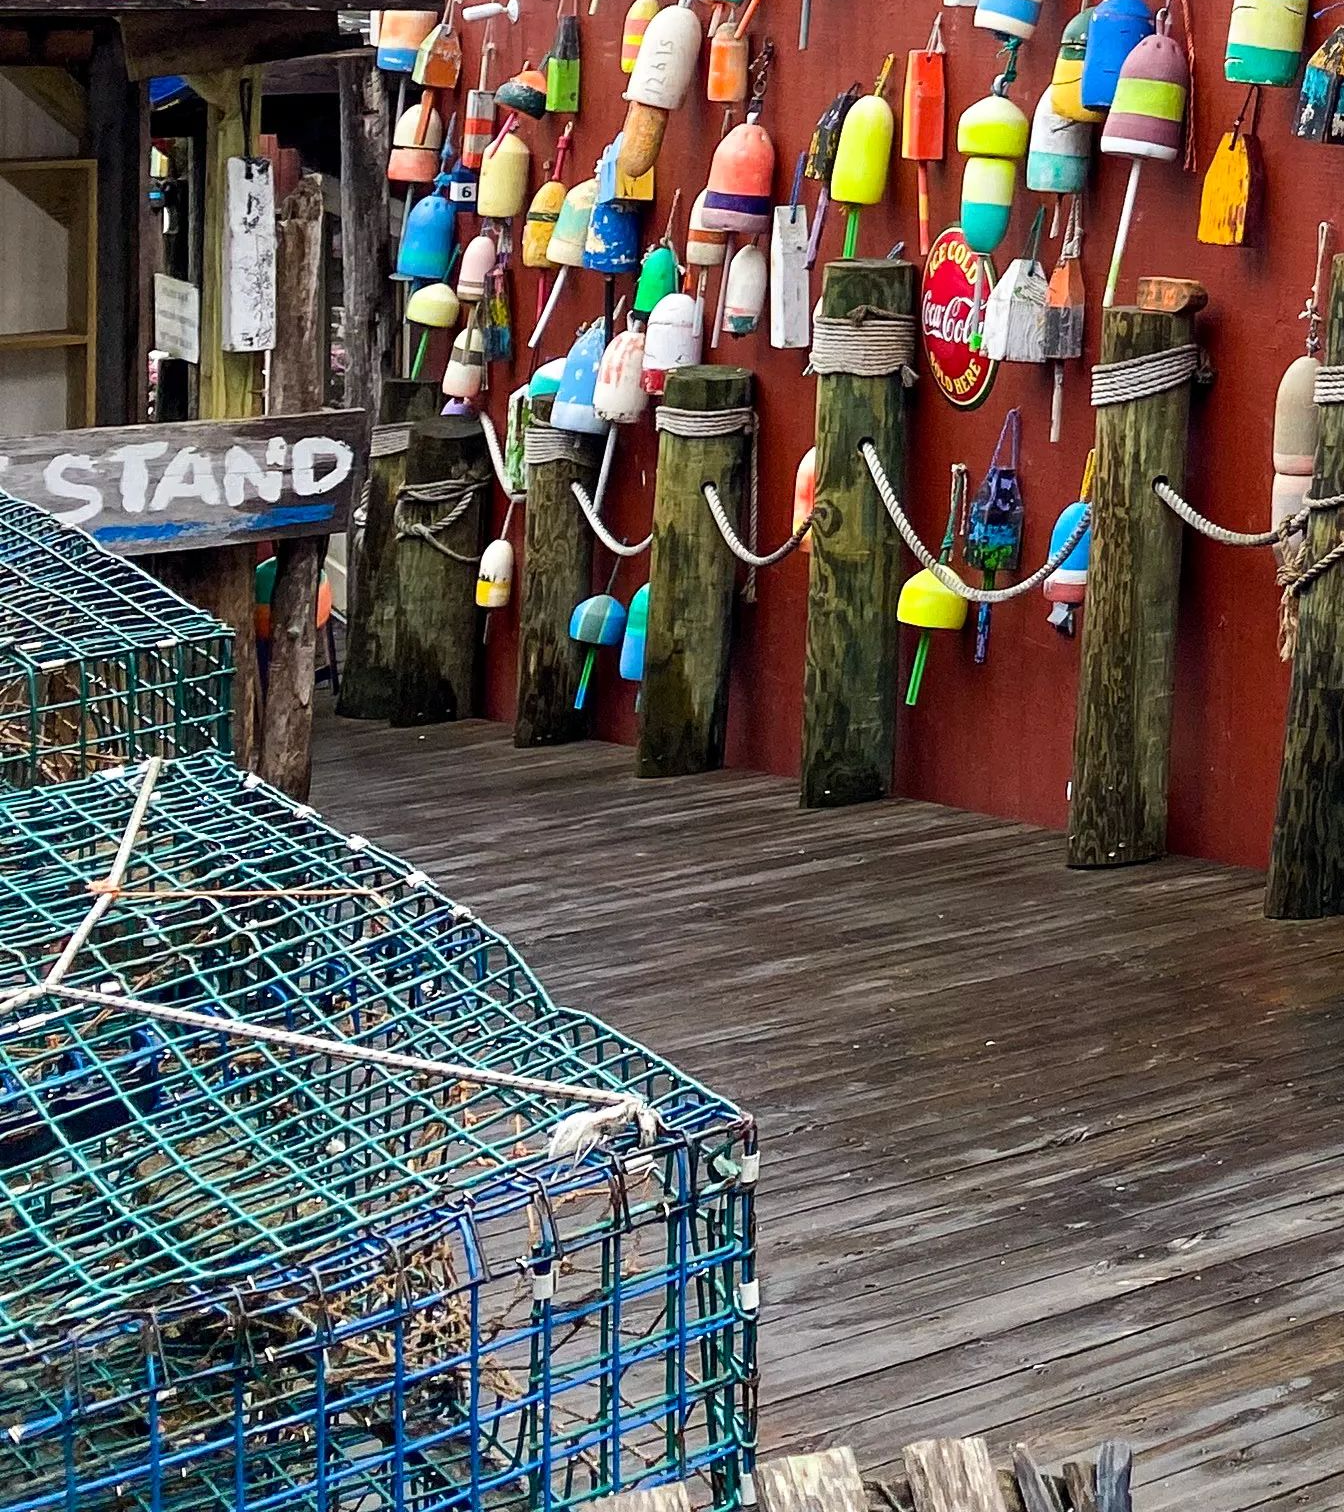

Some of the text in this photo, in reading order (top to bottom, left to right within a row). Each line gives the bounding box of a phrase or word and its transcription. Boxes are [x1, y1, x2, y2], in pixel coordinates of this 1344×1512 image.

[462, 186, 472, 198] 6
[929, 240, 979, 285] ICE COLD
[954, 357, 982, 395] HERE
[43, 435, 354, 526] STAND
